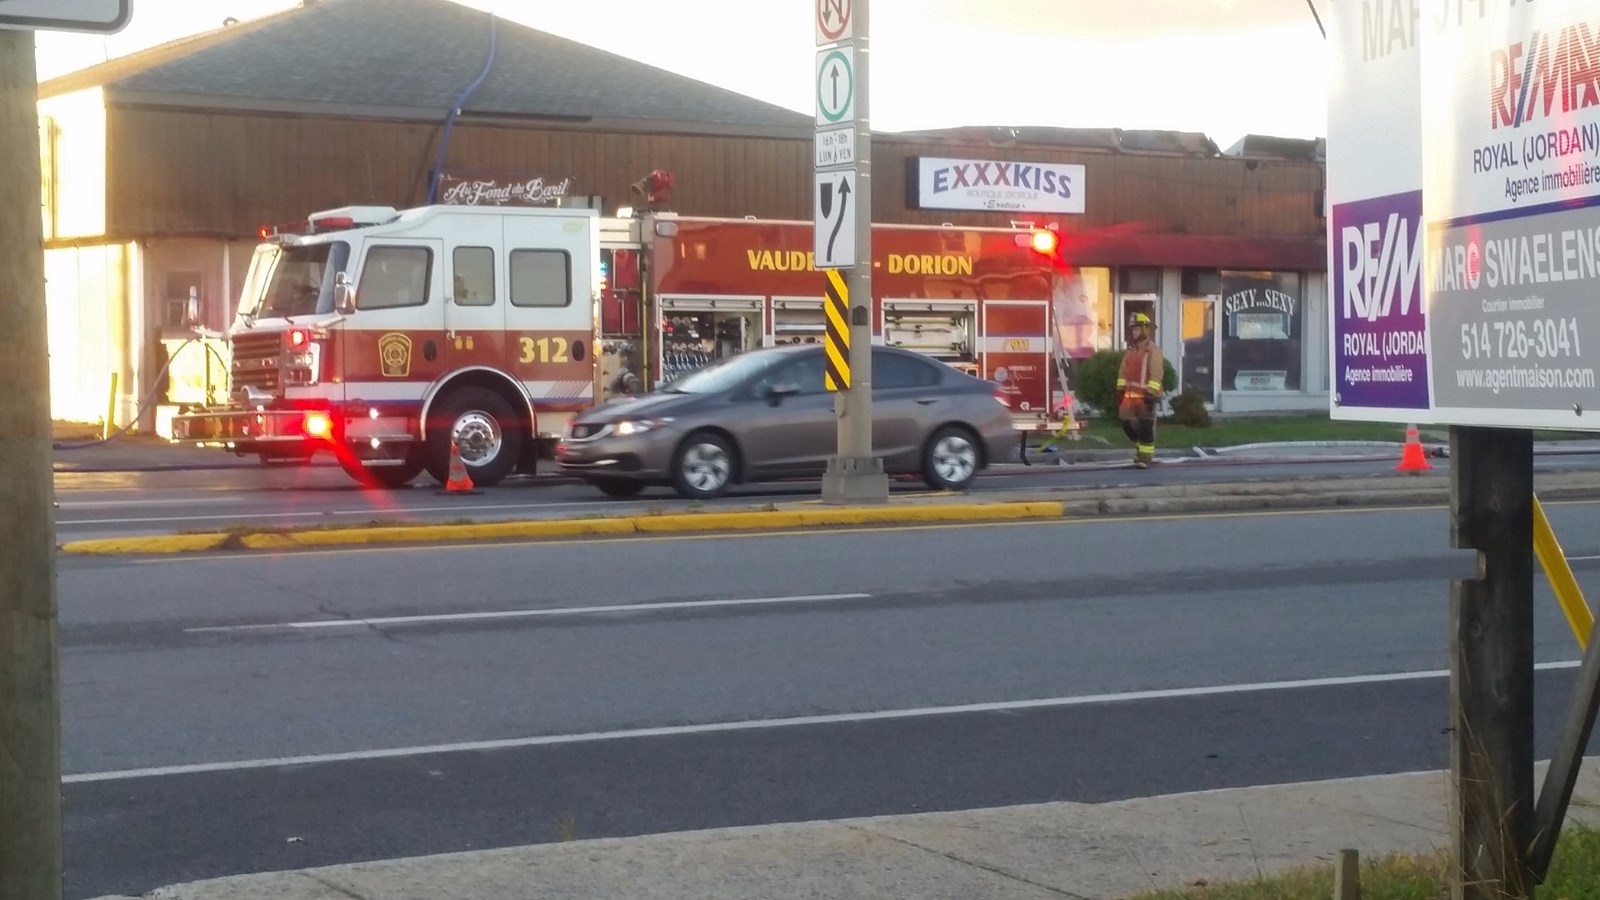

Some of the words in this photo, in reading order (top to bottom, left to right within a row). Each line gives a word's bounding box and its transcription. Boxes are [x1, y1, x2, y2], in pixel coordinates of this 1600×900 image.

[820, 151, 831, 163] LUN
[840, 148, 851, 160] VEN
[1474, 141, 1518, 174] ROYAL
[1523, 122, 1600, 171] (JORDAN)
[444, 181, 472, 200] Au
[466, 180, 512, 205] Fond
[511, 182, 524, 195] du
[523, 177, 569, 201] Baril
[933, 162, 1071, 199] EXXXKISS
[1505, 176, 1539, 203] Agence
[1542, 162, 1600, 192] immobilière
[889, 254, 972, 275] DORION
[1429, 242, 1480, 292] MARC
[1482, 299, 1507, 313] Courtier
[519, 336, 568, 363] 312
[1344, 333, 1380, 357] ROYAL
[1461, 321, 1491, 359] 514
[1494, 317, 1580, 358] 726-3041
[1345, 365, 1371, 386] Agence
[1371, 365, 1413, 382] immobilière
[1456, 363, 1595, 394] www.agentmaison.com
